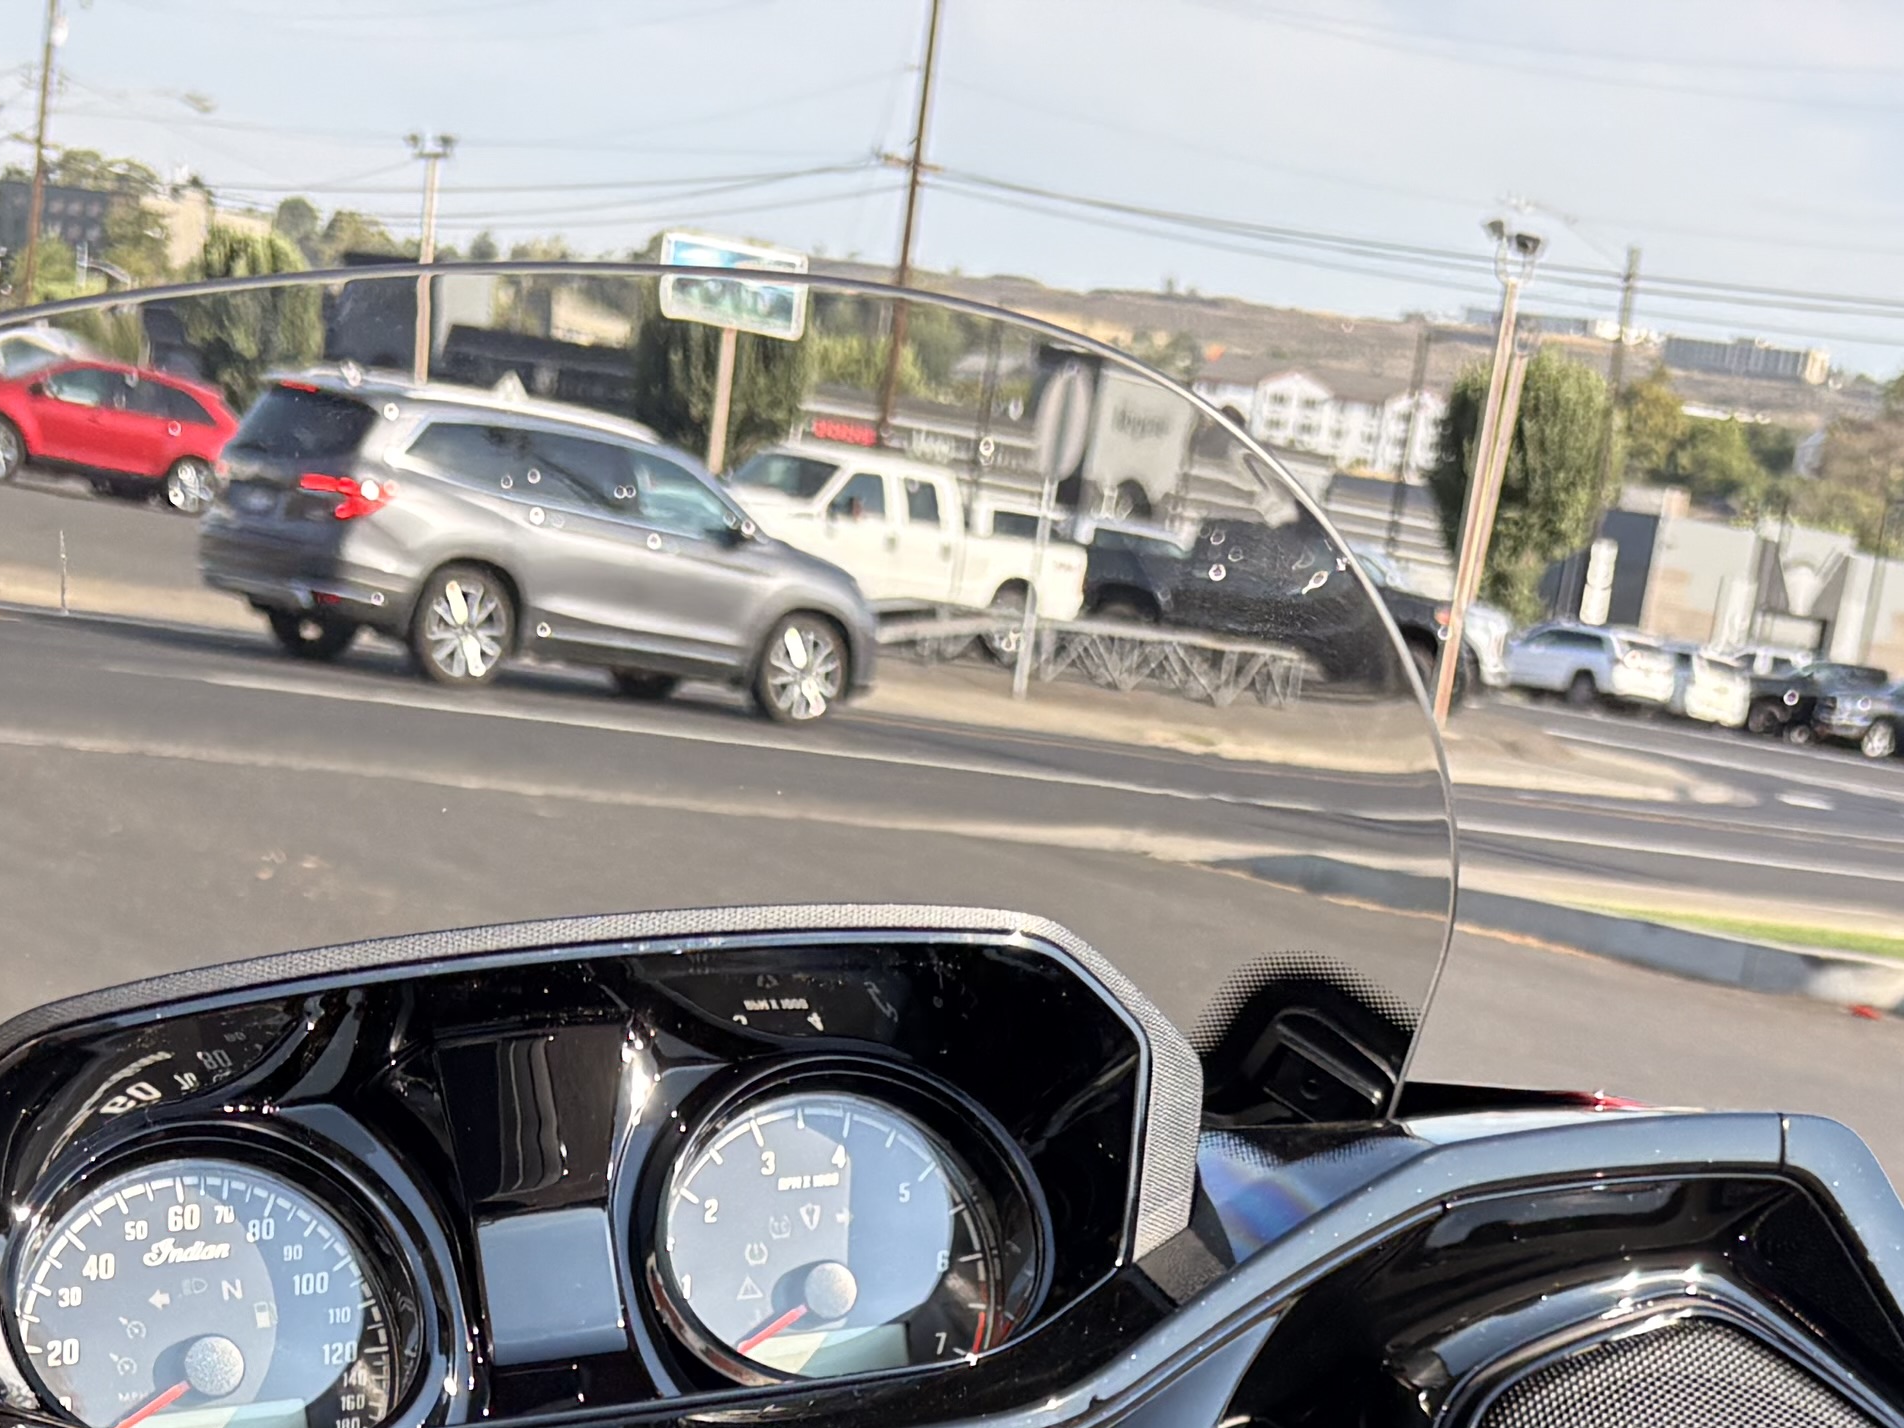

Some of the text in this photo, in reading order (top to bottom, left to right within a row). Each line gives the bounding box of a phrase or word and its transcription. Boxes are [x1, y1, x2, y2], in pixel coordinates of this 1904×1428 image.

[761, 1151, 776, 1176] 3
[831, 1144, 847, 1169] 4
[898, 1183, 910, 1203] 5
[168, 1204, 200, 1231] 60
[214, 1205, 235, 1224] 70
[704, 1198, 719, 1224] 2
[124, 1221, 149, 1241] 50
[247, 1218, 275, 1242] 80
[143, 1238, 230, 1266] Indian
[283, 1244, 303, 1261] 90
[936, 1249, 949, 1272] 6
[82, 1253, 115, 1281] 40
[221, 1279, 243, 1301] N
[292, 1272, 329, 1296] 100
[681, 1274, 692, 1300] 1
[58, 1286, 82, 1308] 30
[328, 1308, 351, 1325] 110
[47, 1338, 80, 1368] 20
[322, 1342, 358, 1365] 120
[934, 1332, 947, 1355] 7
[343, 1369, 367, 1388] 140
[340, 1394, 365, 1412] 160
